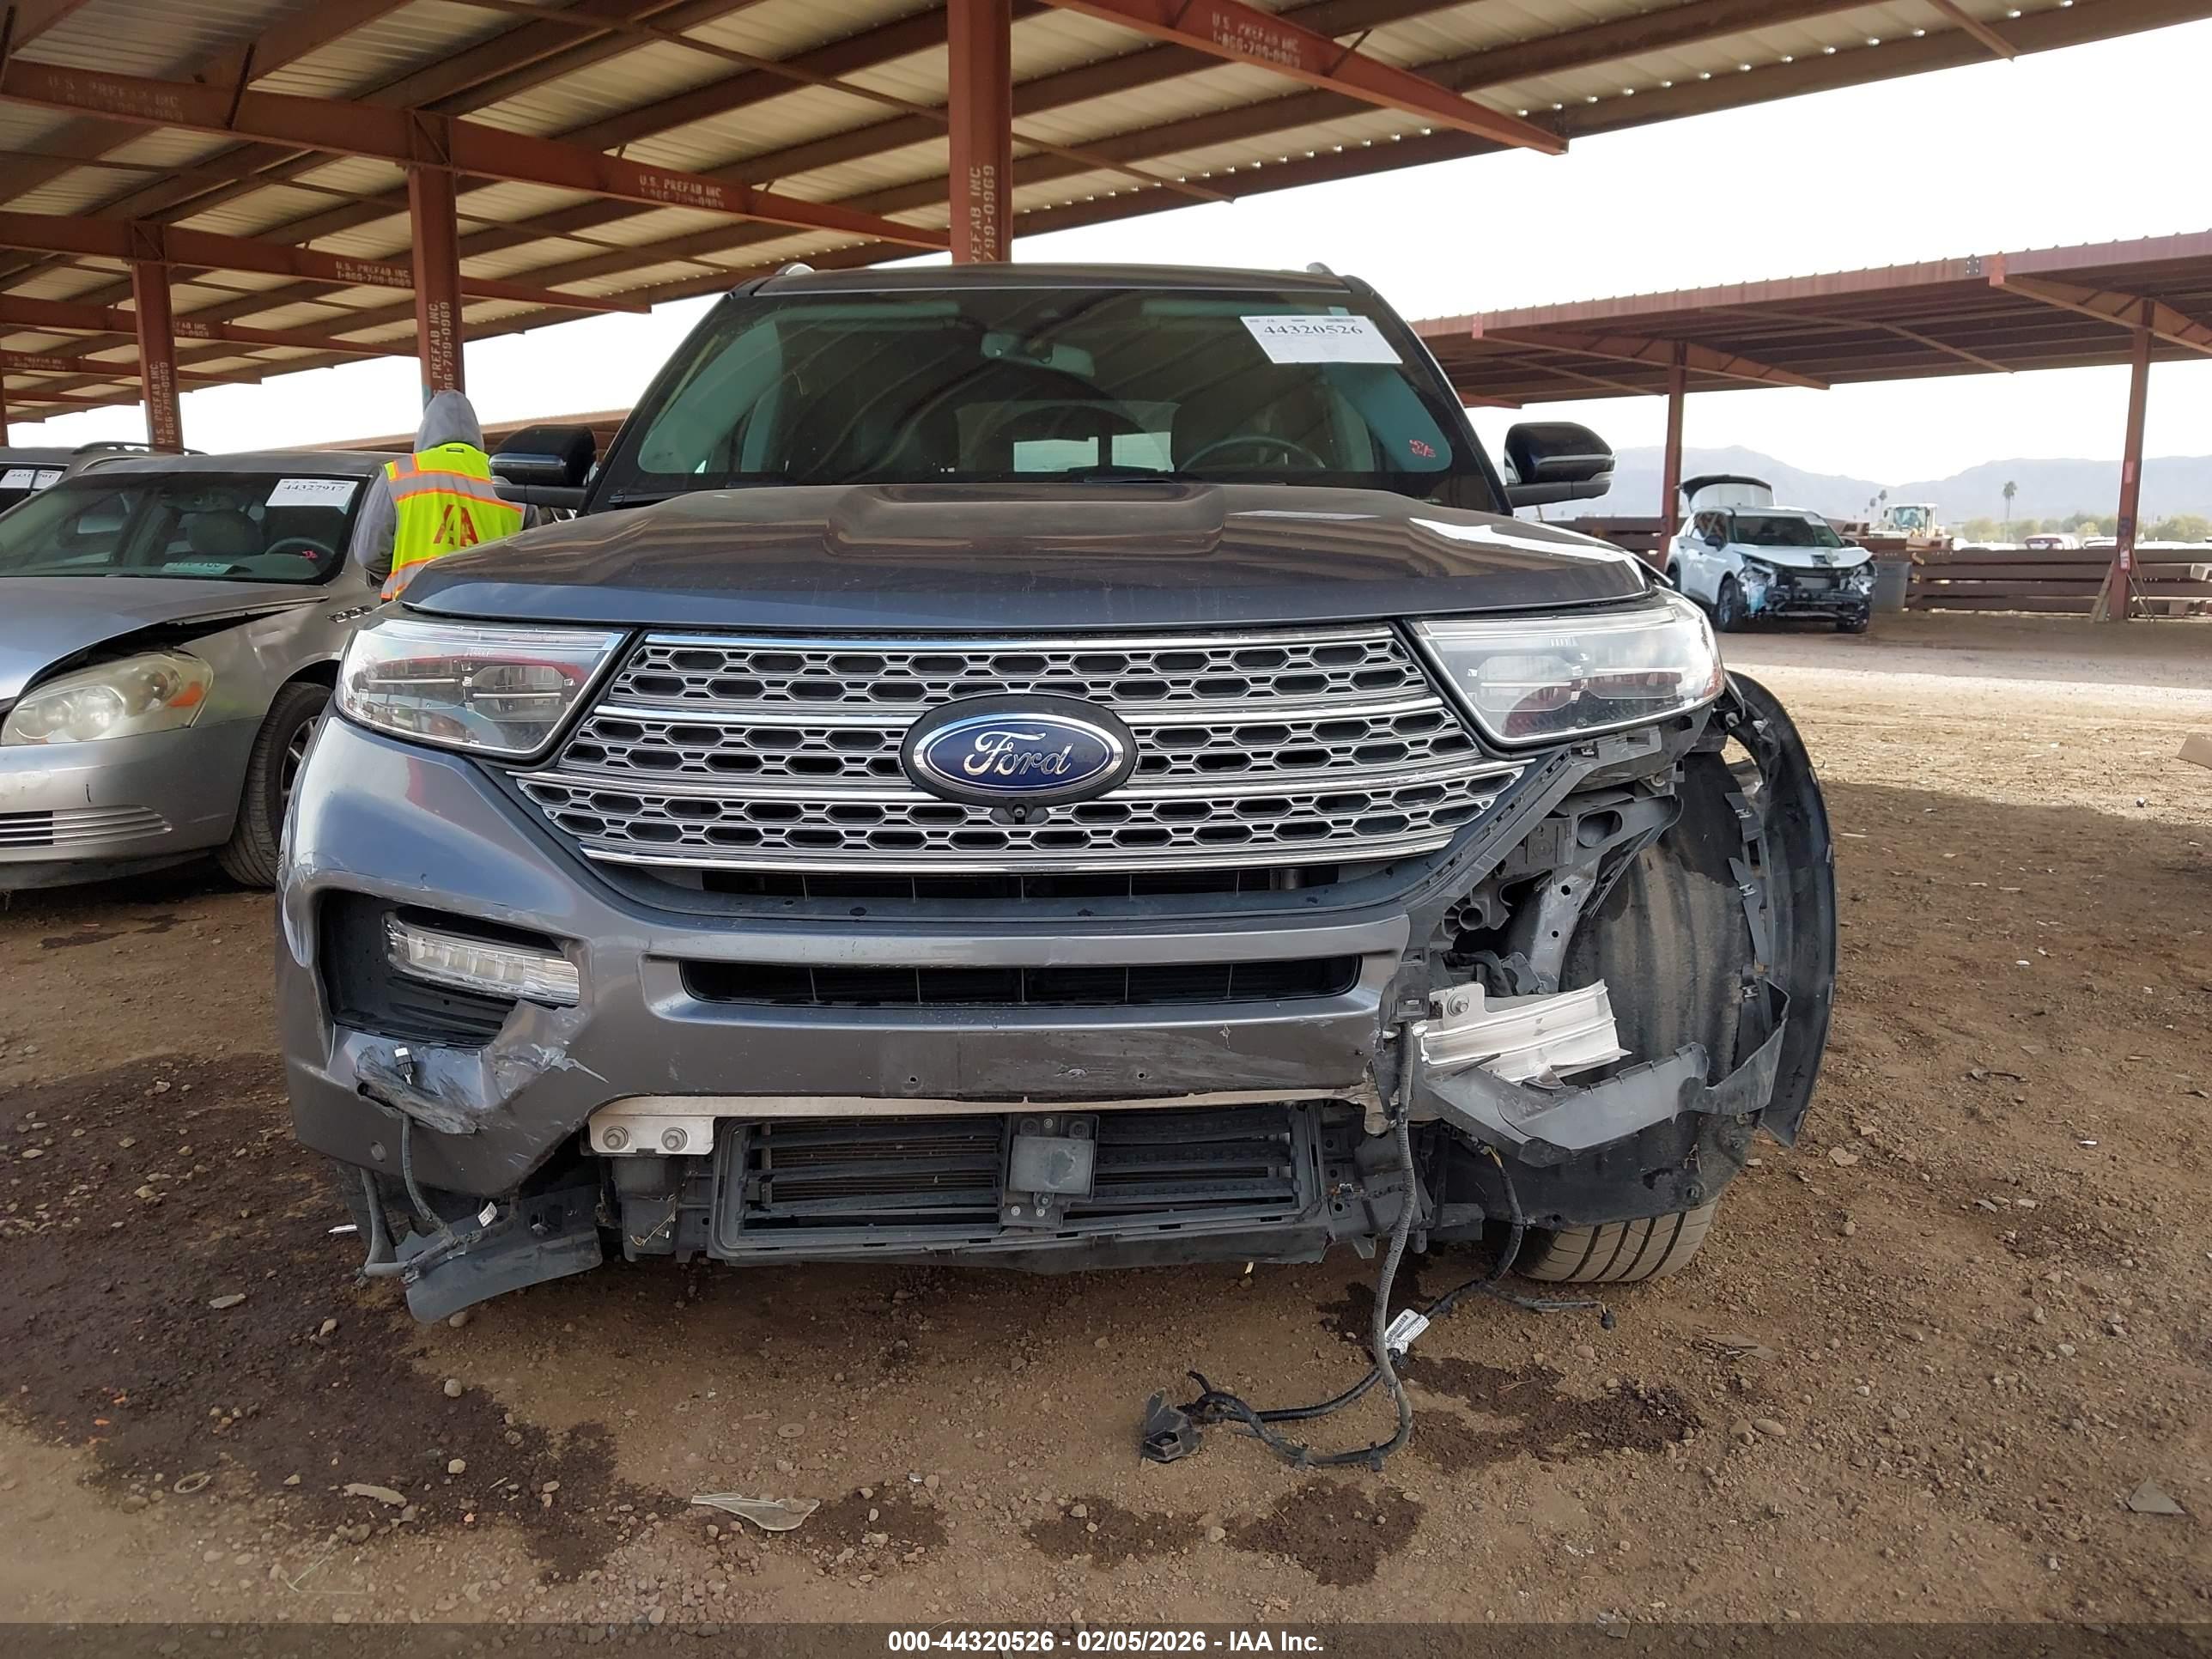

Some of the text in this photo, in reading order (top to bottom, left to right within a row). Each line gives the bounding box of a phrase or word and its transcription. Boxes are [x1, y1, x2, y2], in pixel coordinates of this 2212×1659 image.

[1264, 325, 1364, 335] 44320526
[430, 330, 443, 379] PREFAB
[963, 731, 1073, 775] Ford
